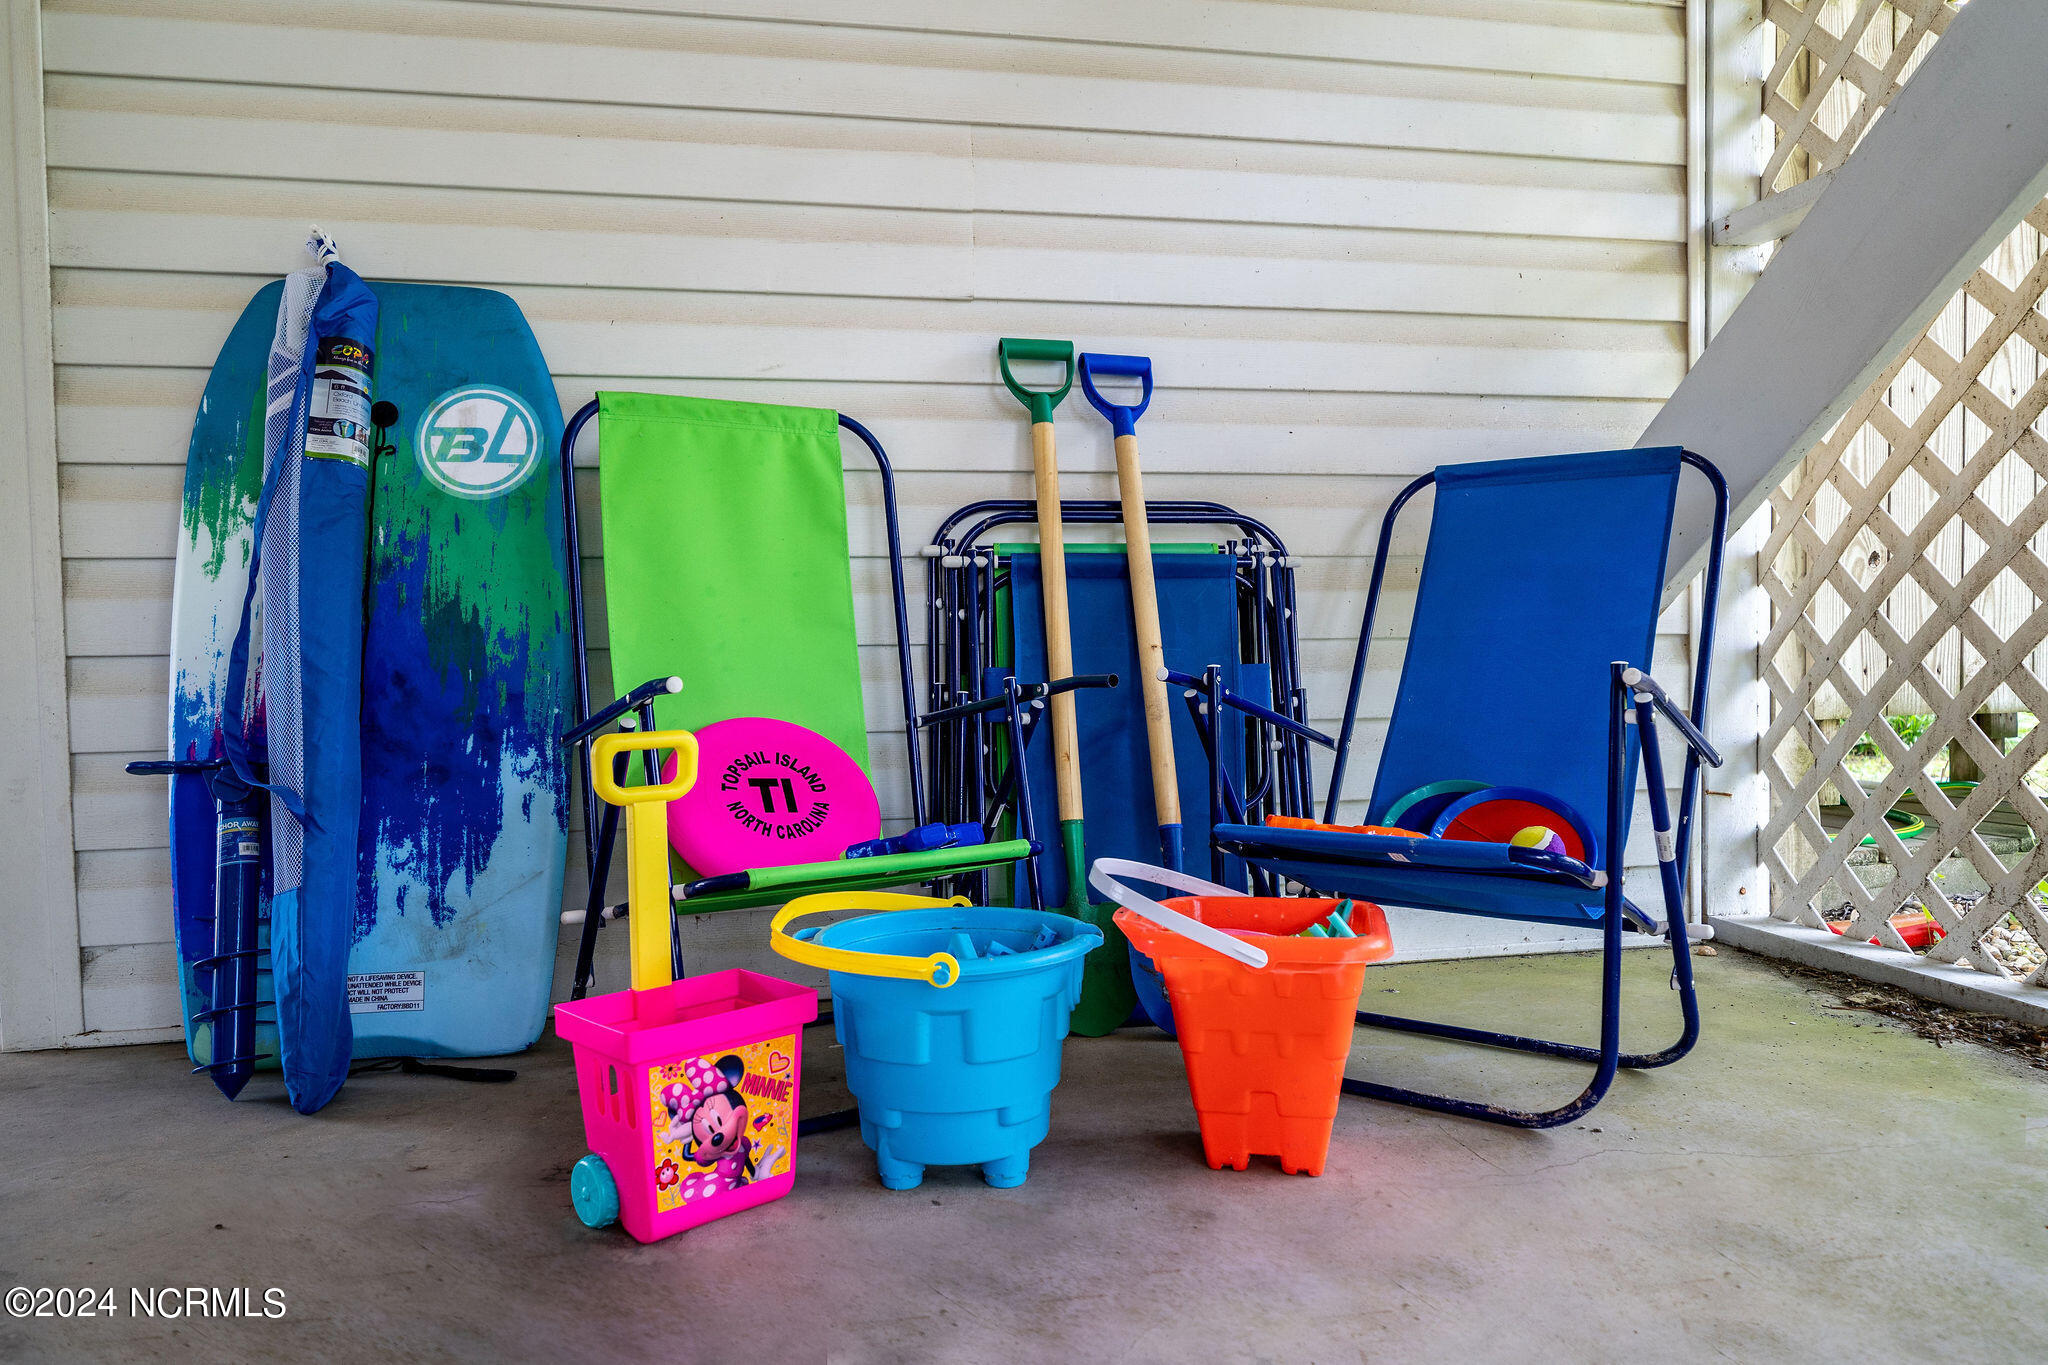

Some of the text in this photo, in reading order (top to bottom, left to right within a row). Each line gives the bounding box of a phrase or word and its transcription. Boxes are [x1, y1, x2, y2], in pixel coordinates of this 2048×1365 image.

[331, 344, 369, 365] COPA
[333, 391, 353, 400] Oxford
[721, 751, 827, 793] TOPSAIL ISLAND
[747, 778, 799, 813] TI
[726, 801, 830, 839] NORTH CAROLINA
[365, 973, 396, 982] LIFESAVING
[384, 987, 409, 995] PROTECT
[740, 1071, 793, 1103] MINNIE
